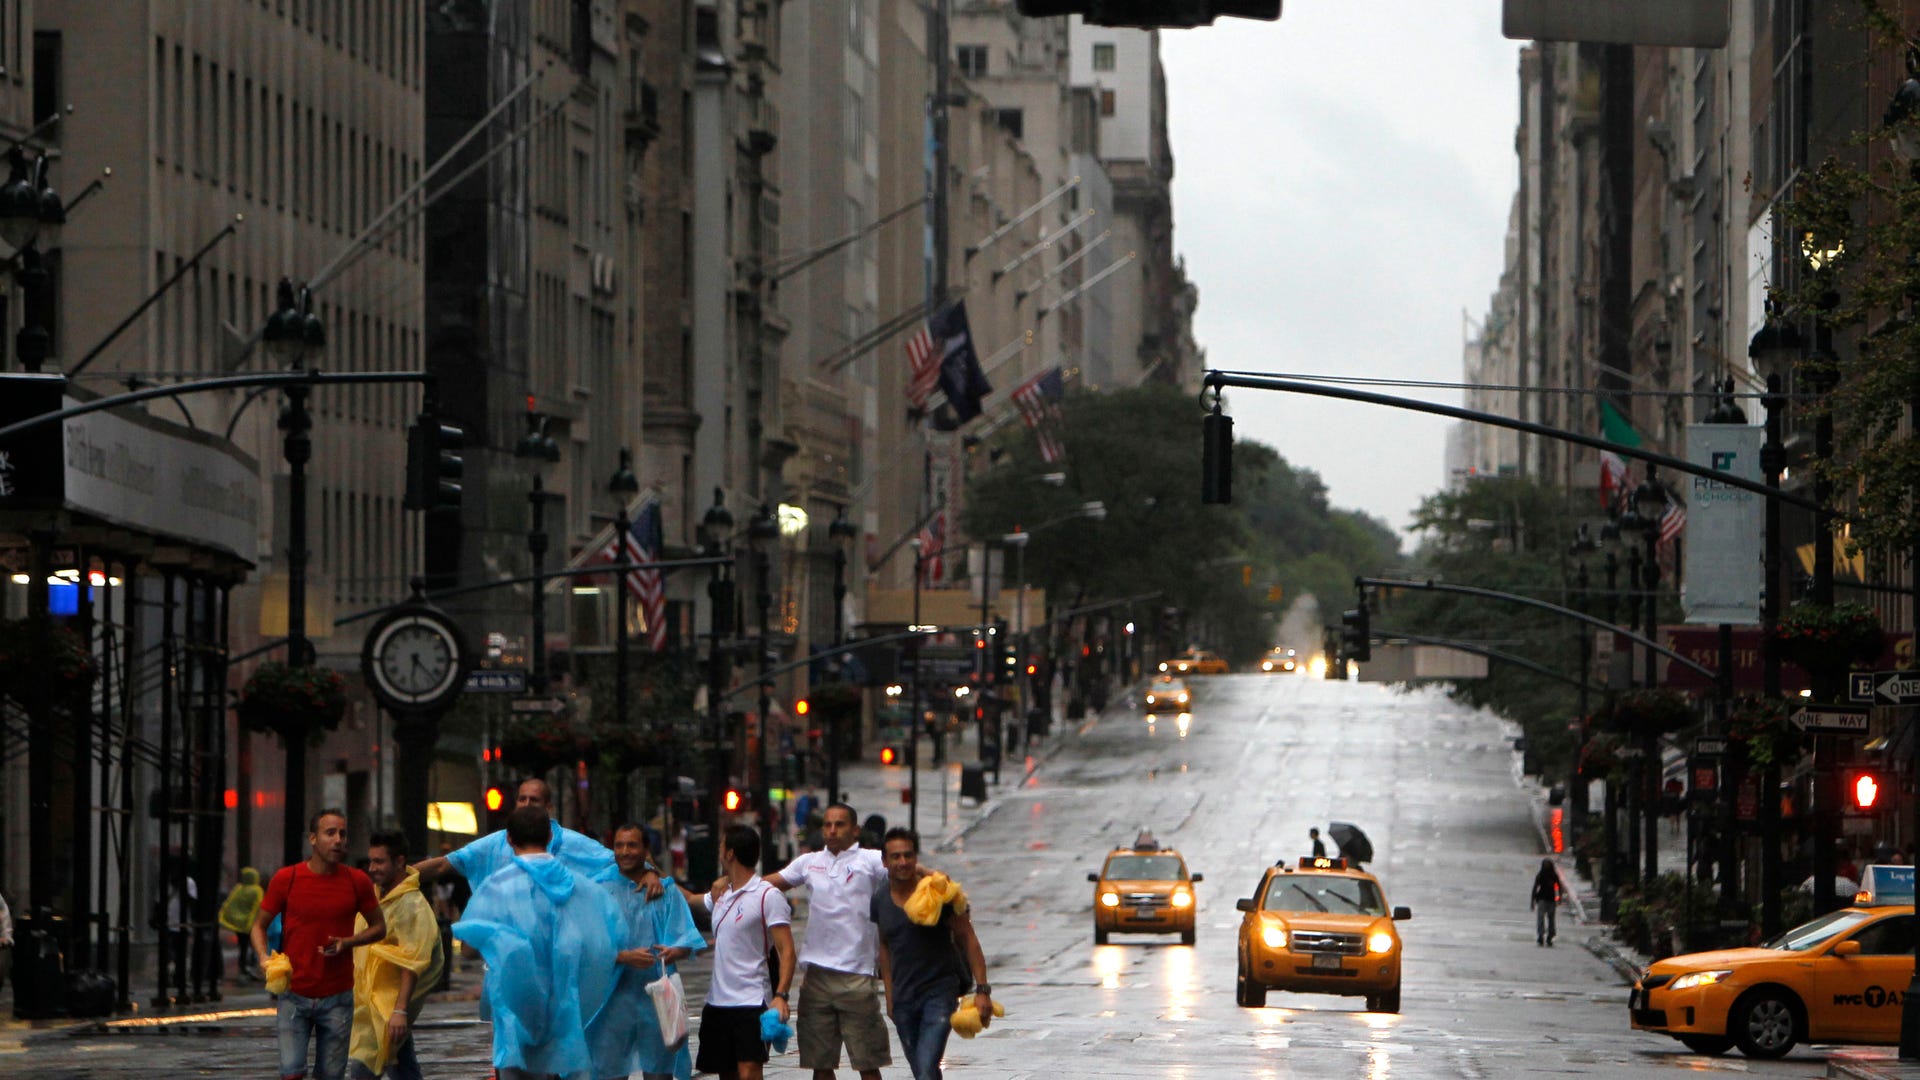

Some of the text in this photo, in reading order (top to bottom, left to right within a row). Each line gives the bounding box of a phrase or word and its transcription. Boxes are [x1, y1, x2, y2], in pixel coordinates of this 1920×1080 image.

[1890, 681, 1920, 696] ONE
[1797, 712, 1864, 728] ONE WAY
[1833, 993, 1863, 1006] NYC
